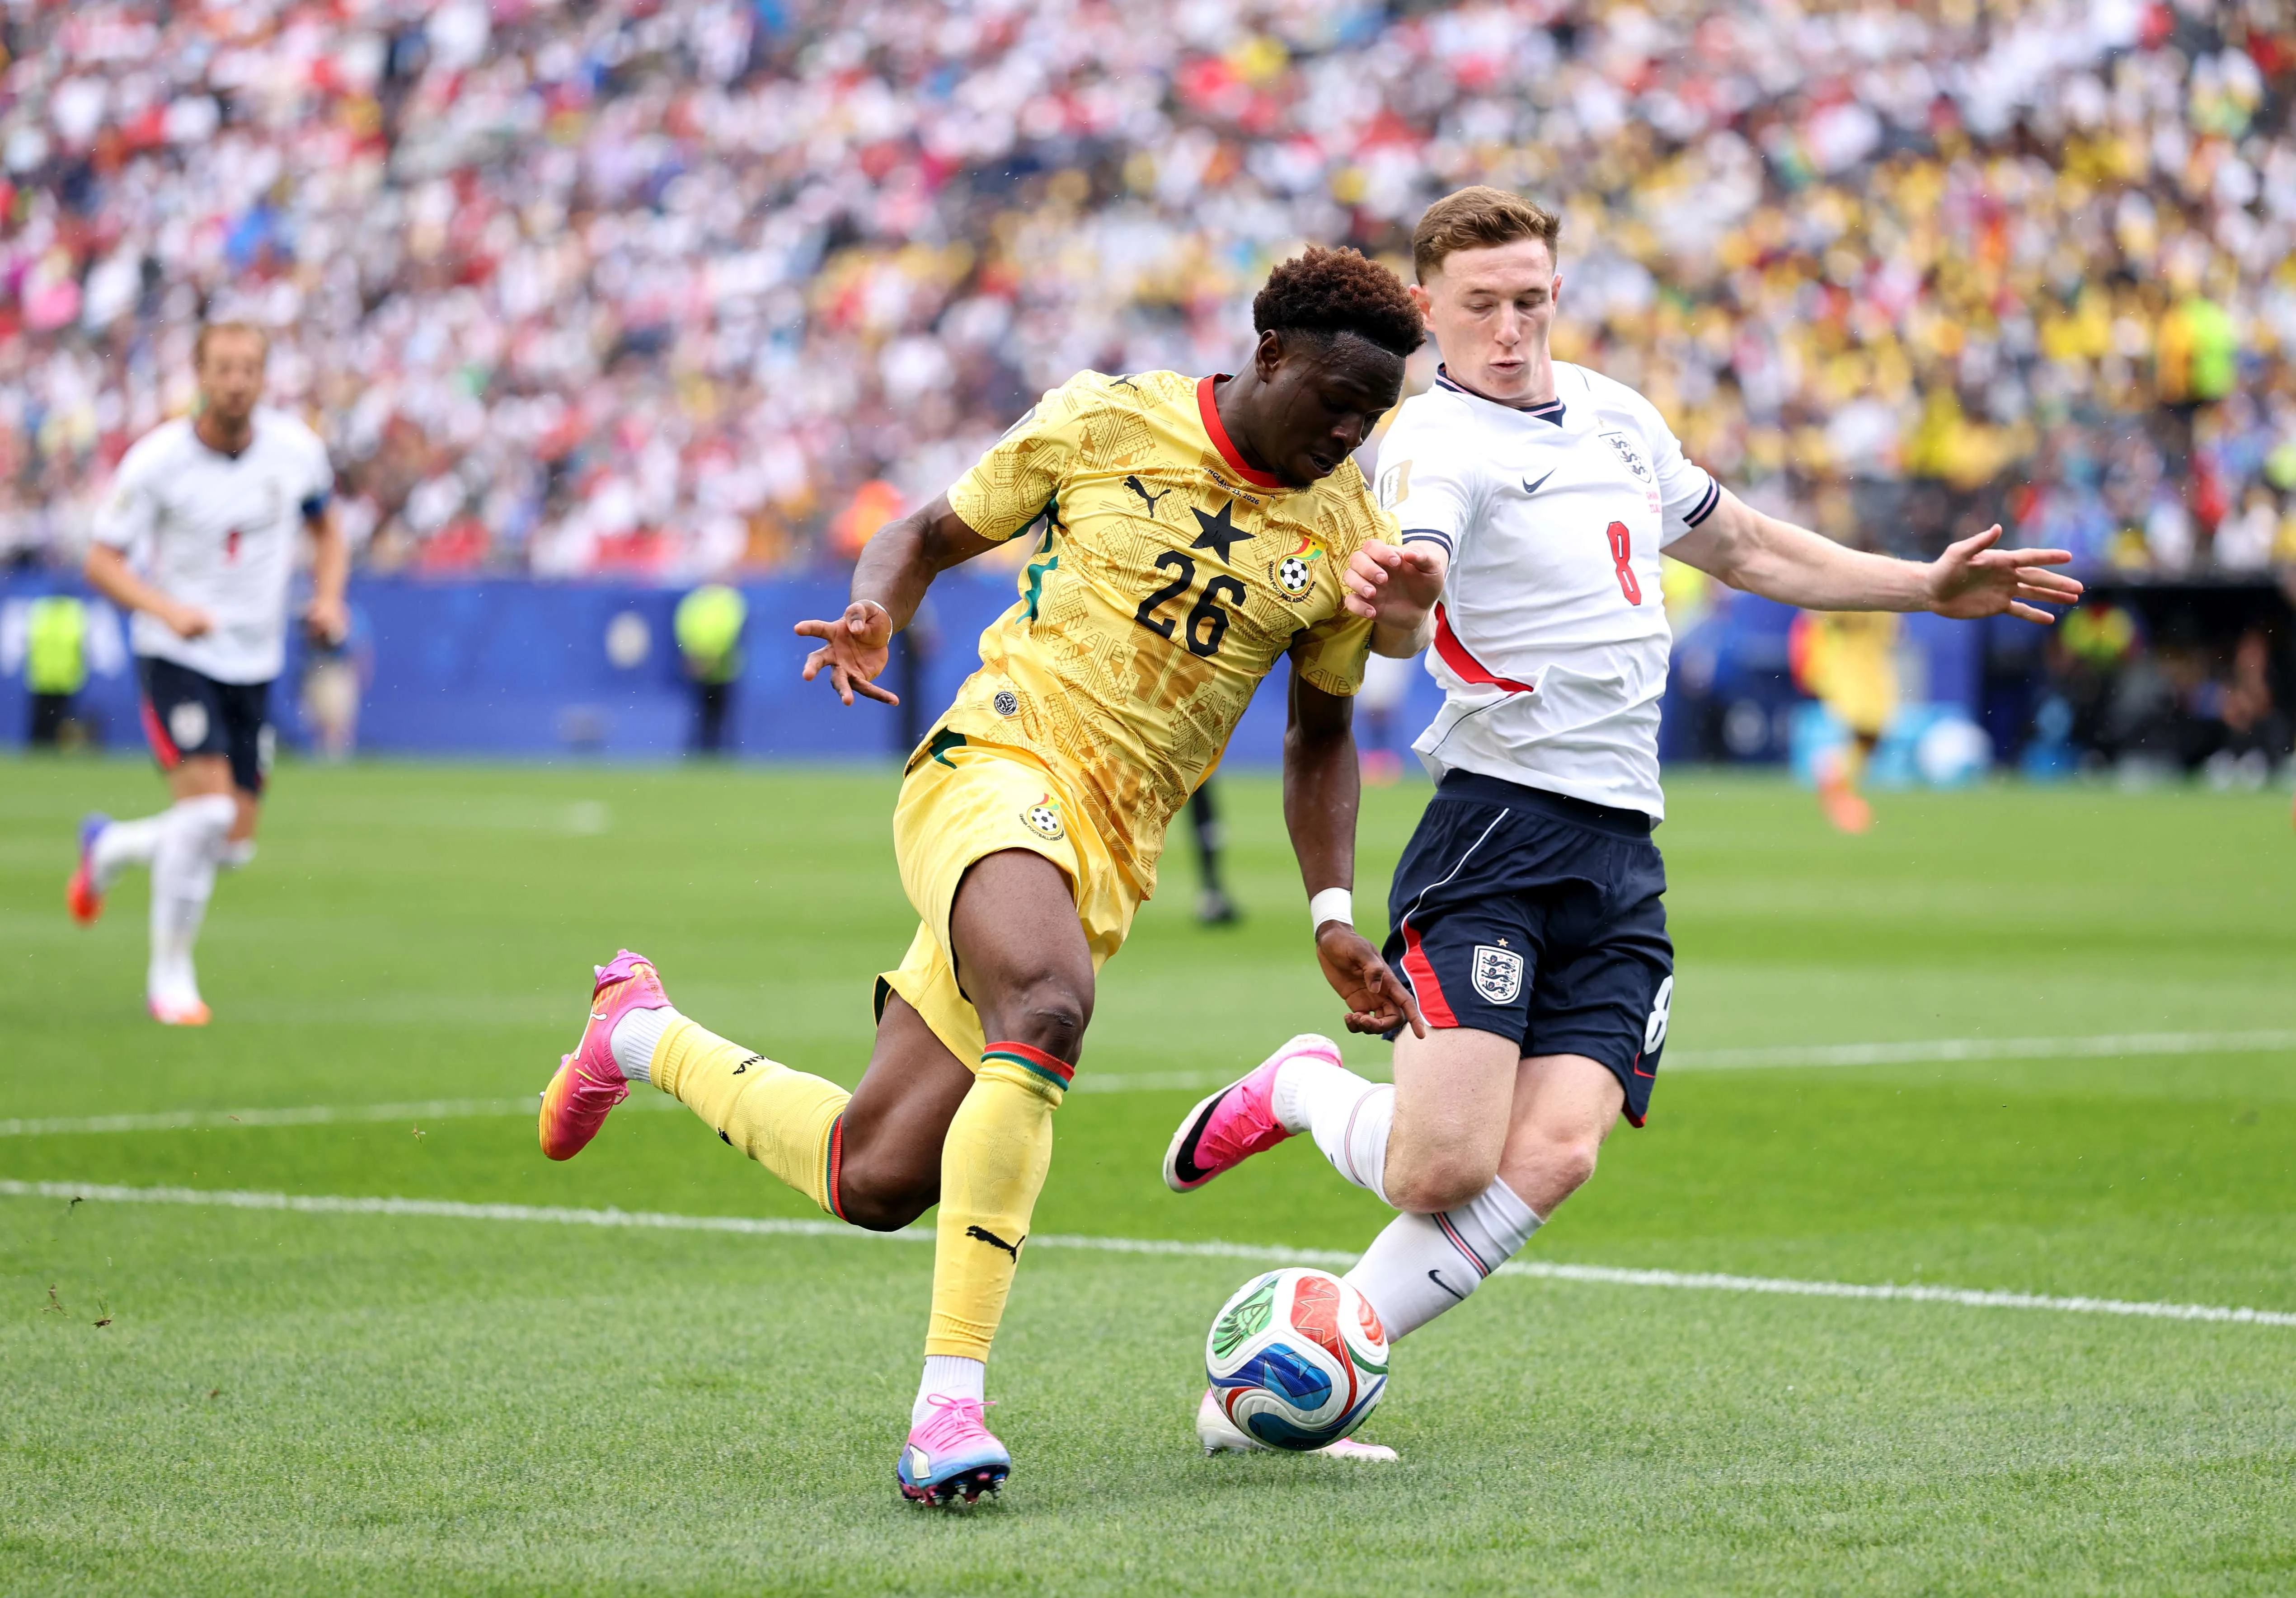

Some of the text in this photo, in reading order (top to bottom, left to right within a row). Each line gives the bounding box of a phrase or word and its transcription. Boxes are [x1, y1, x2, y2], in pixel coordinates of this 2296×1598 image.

[1243, 493, 1260, 505] 2026
[1606, 521, 1642, 606] 8
[1134, 550, 1247, 657] 26
[1271, 581, 1291, 602] FOOTBALL
[1027, 825, 1050, 840] FOOTBALL
[1643, 975, 1674, 1055] 8
